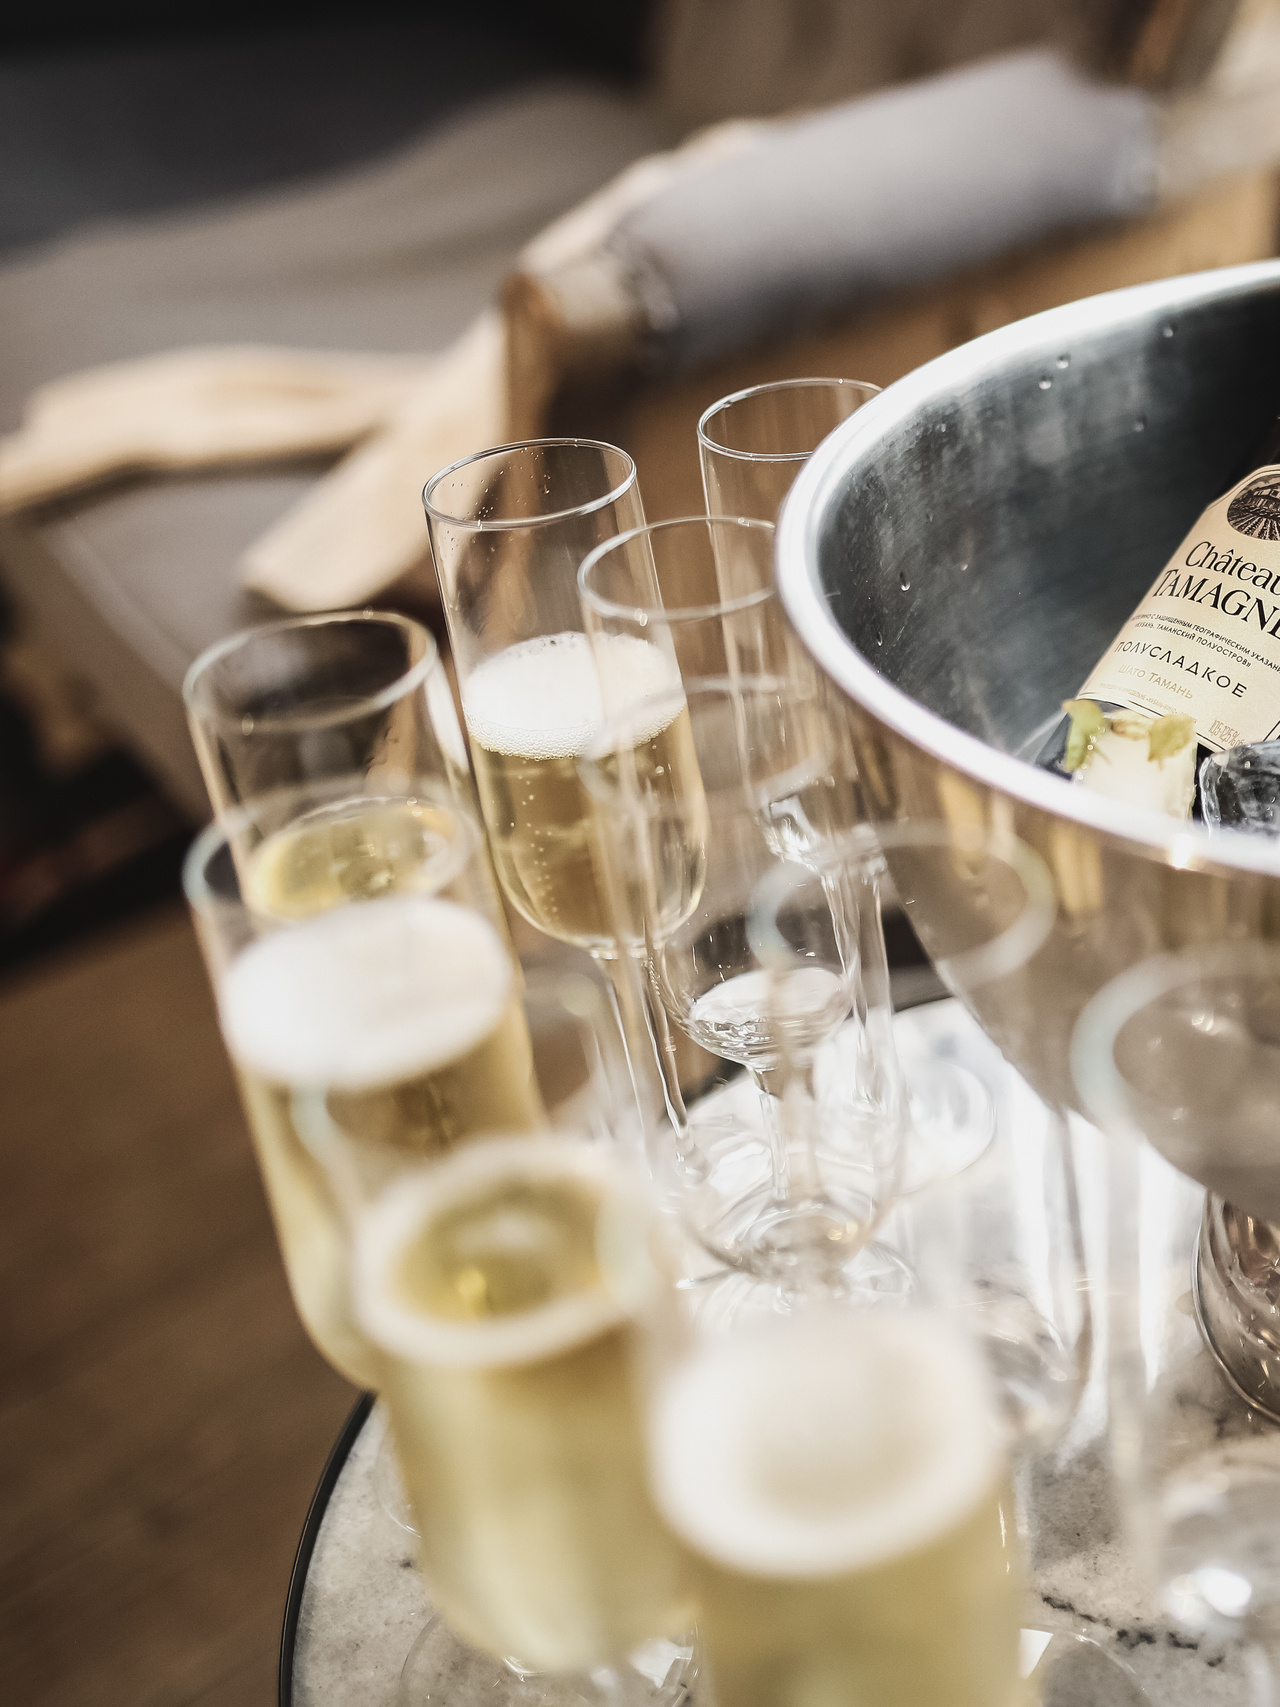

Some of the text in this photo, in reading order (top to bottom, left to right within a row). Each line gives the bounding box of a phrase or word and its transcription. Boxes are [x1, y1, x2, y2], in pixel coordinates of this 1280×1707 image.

[1156, 623, 1195, 640] ТАМАНСКИЙ
[1196, 636, 1251, 668] ПОЛУОСТРОВ»
[1193, 624, 1250, 655] ГЕОГРАФИЧЕСКИМ
[1114, 641, 1247, 698] ПОЛУСЛАДКОЕ
